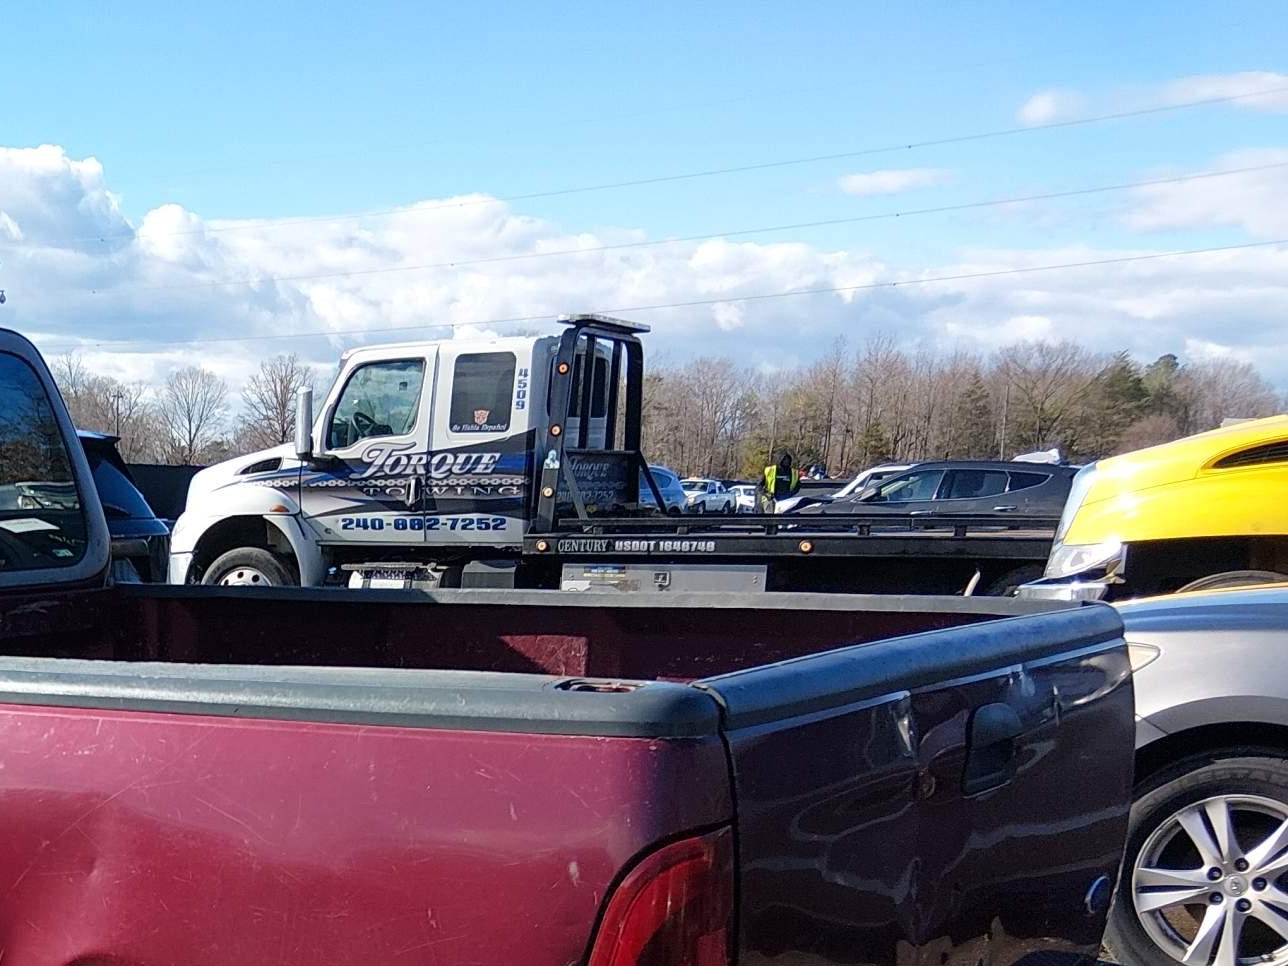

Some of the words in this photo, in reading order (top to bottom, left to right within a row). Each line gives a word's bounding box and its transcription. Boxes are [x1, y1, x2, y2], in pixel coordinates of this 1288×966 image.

[515, 368, 529, 410] 4509
[363, 486, 521, 496] TOWING
[341, 517, 507, 531] 240-882-7252
[558, 539, 609, 552] CENTURY
[614, 540, 657, 552] USDOT
